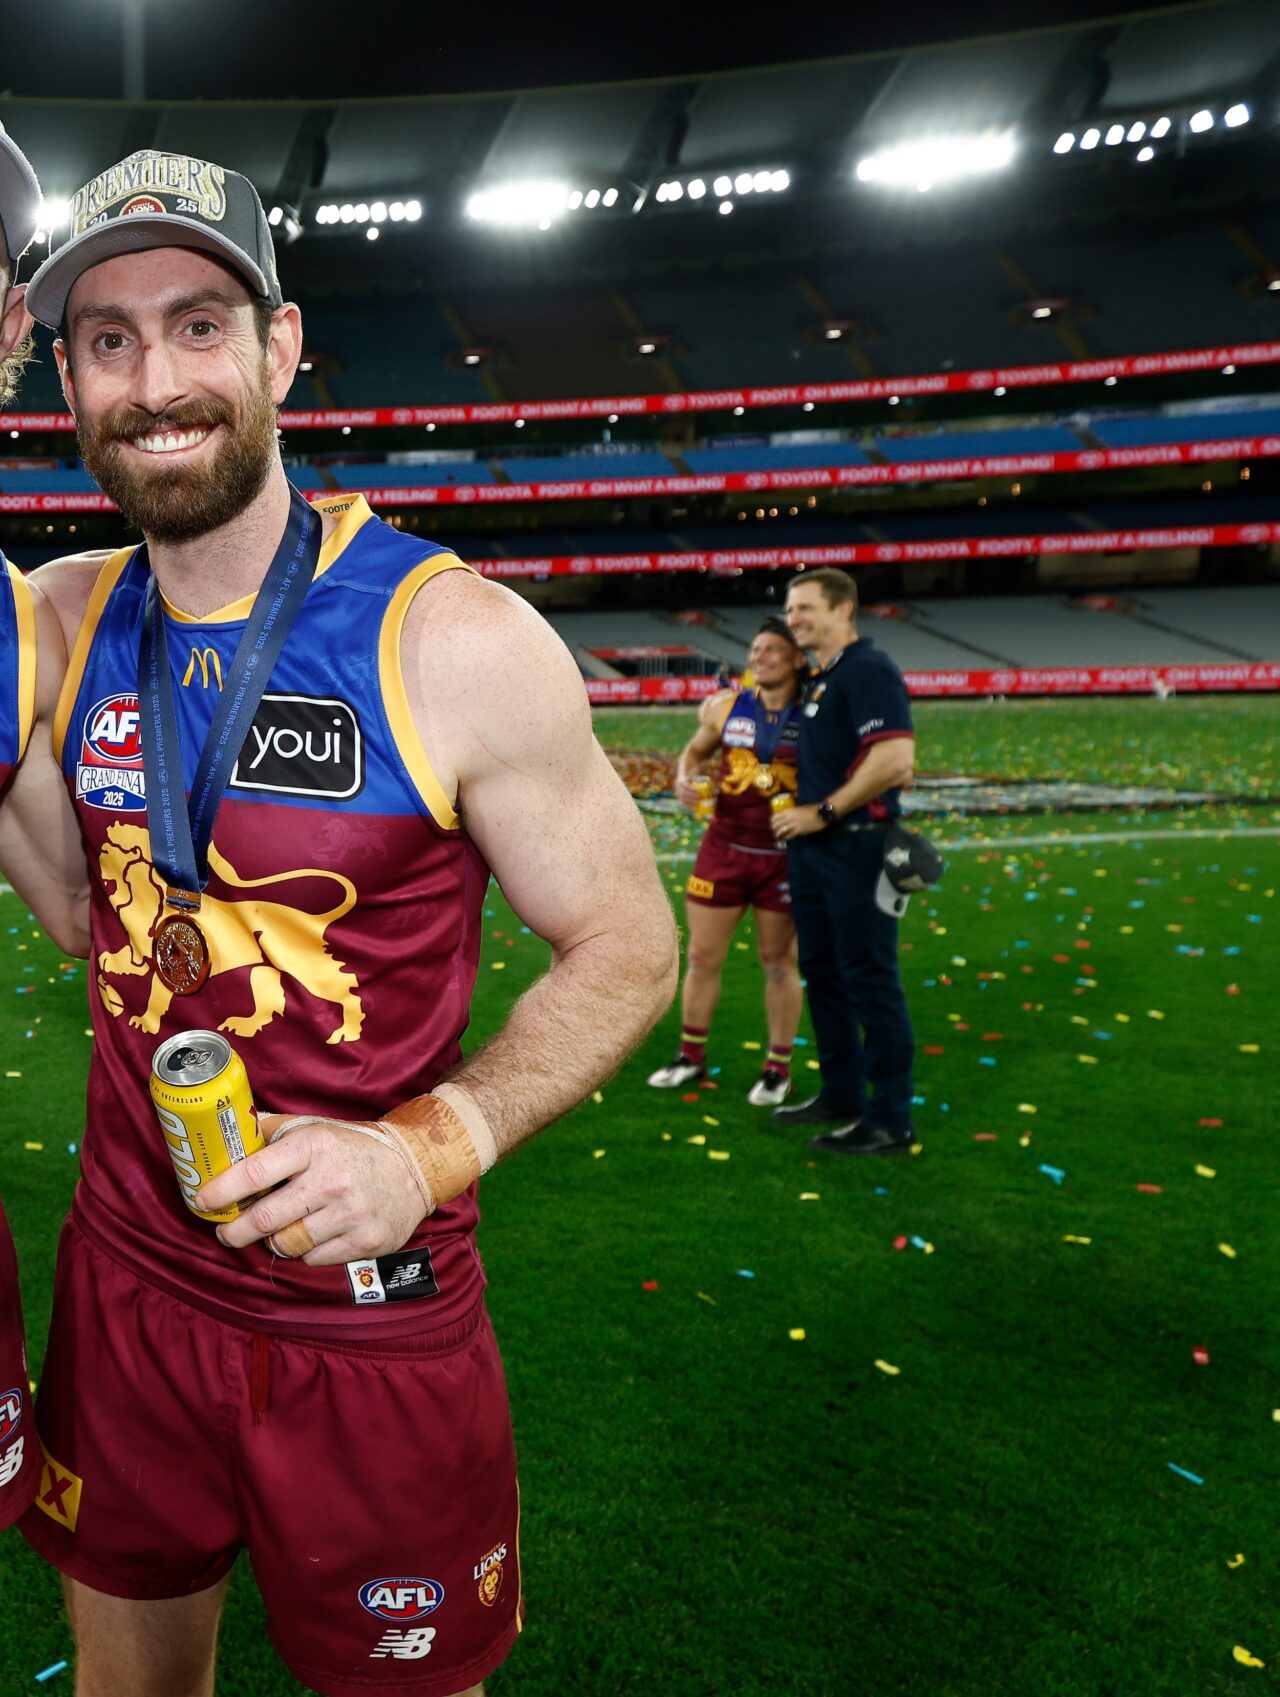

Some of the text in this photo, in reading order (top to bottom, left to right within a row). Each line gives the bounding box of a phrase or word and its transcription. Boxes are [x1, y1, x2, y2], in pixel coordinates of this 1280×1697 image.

[72, 157, 226, 236] PREMIERS
[176, 198, 198, 213] 25
[128, 205, 156, 214] LIONS
[688, 391, 743, 408] TOYOTA
[415, 408, 465, 421] TOYOTA
[1109, 445, 1180, 465] TOYOTA
[772, 470, 830, 488] TOYOTA
[478, 485, 531, 500] TOYOTA
[323, 503, 353, 514] FOOTB
[295, 539, 306, 558] 2025
[904, 541, 969, 558] TOYOTA
[594, 556, 650, 570] TOYOTA
[256, 578, 292, 650] AFL PREMIERS 2025
[1021, 670, 1090, 685] TOYOTA
[152, 694, 160, 713] 2025
[220, 668, 252, 745] AFL PREMIERS 2025
[90, 710, 142, 745] AF
[154, 714, 162, 754] PREMIERS
[249, 718, 341, 769] youi
[80, 767, 145, 795] GRAND FINA
[207, 766, 217, 781] AFL
[104, 790, 124, 806] 2025
[164, 807, 174, 848] PREMIERS
[168, 848, 177, 864] AFL
[162, 1092, 204, 1104] QUEENSLAND
[196, 1132, 213, 1178] AVOURED LAGER
[386, 1275, 428, 1290] new balance
[474, 1543, 507, 1580] LIONS
[368, 1586, 436, 1609] AFL
